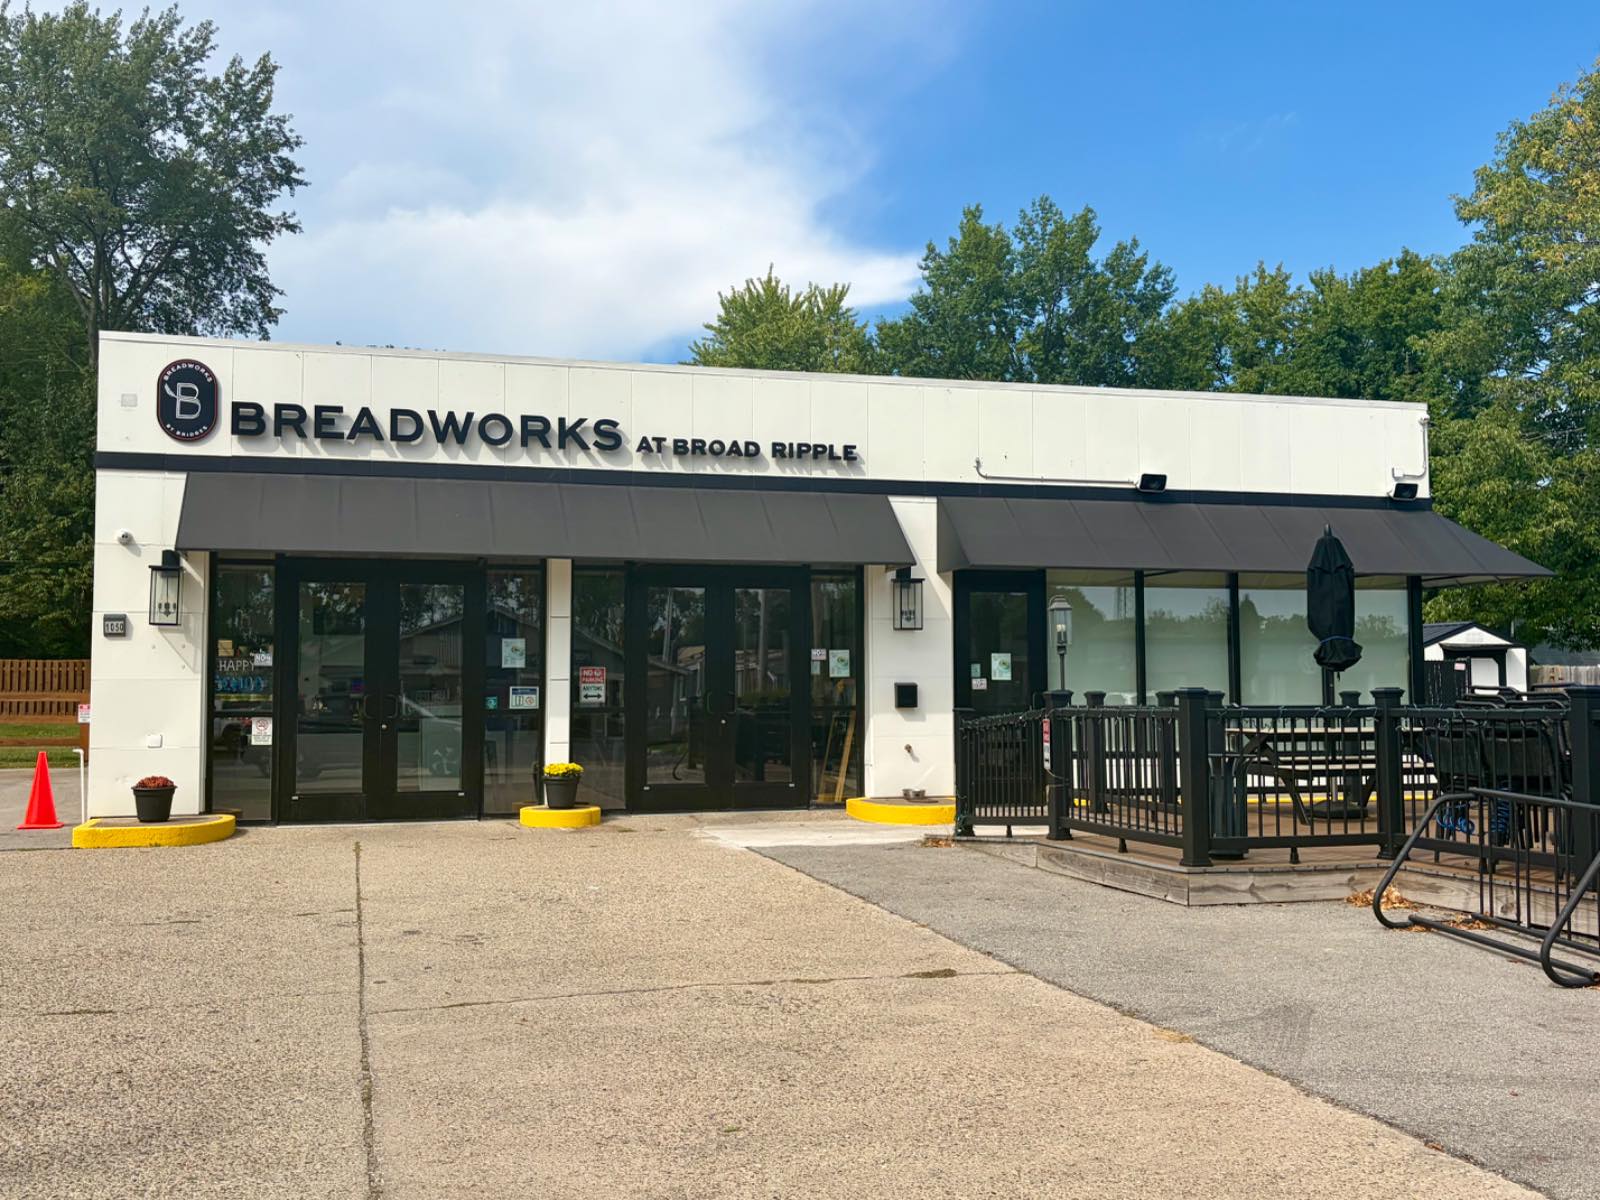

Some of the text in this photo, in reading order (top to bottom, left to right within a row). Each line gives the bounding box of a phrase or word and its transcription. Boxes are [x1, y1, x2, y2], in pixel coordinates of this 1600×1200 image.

[163, 363, 213, 382] BREADWORKS
[165, 383, 201, 419] B
[231, 401, 622, 451] BREADWORKS
[636, 436, 858, 461] AT BROAD RIPPLE
[105, 622, 124, 632] 1050
[219, 659, 255, 671] HAPPY
[583, 669, 593, 677] NO
